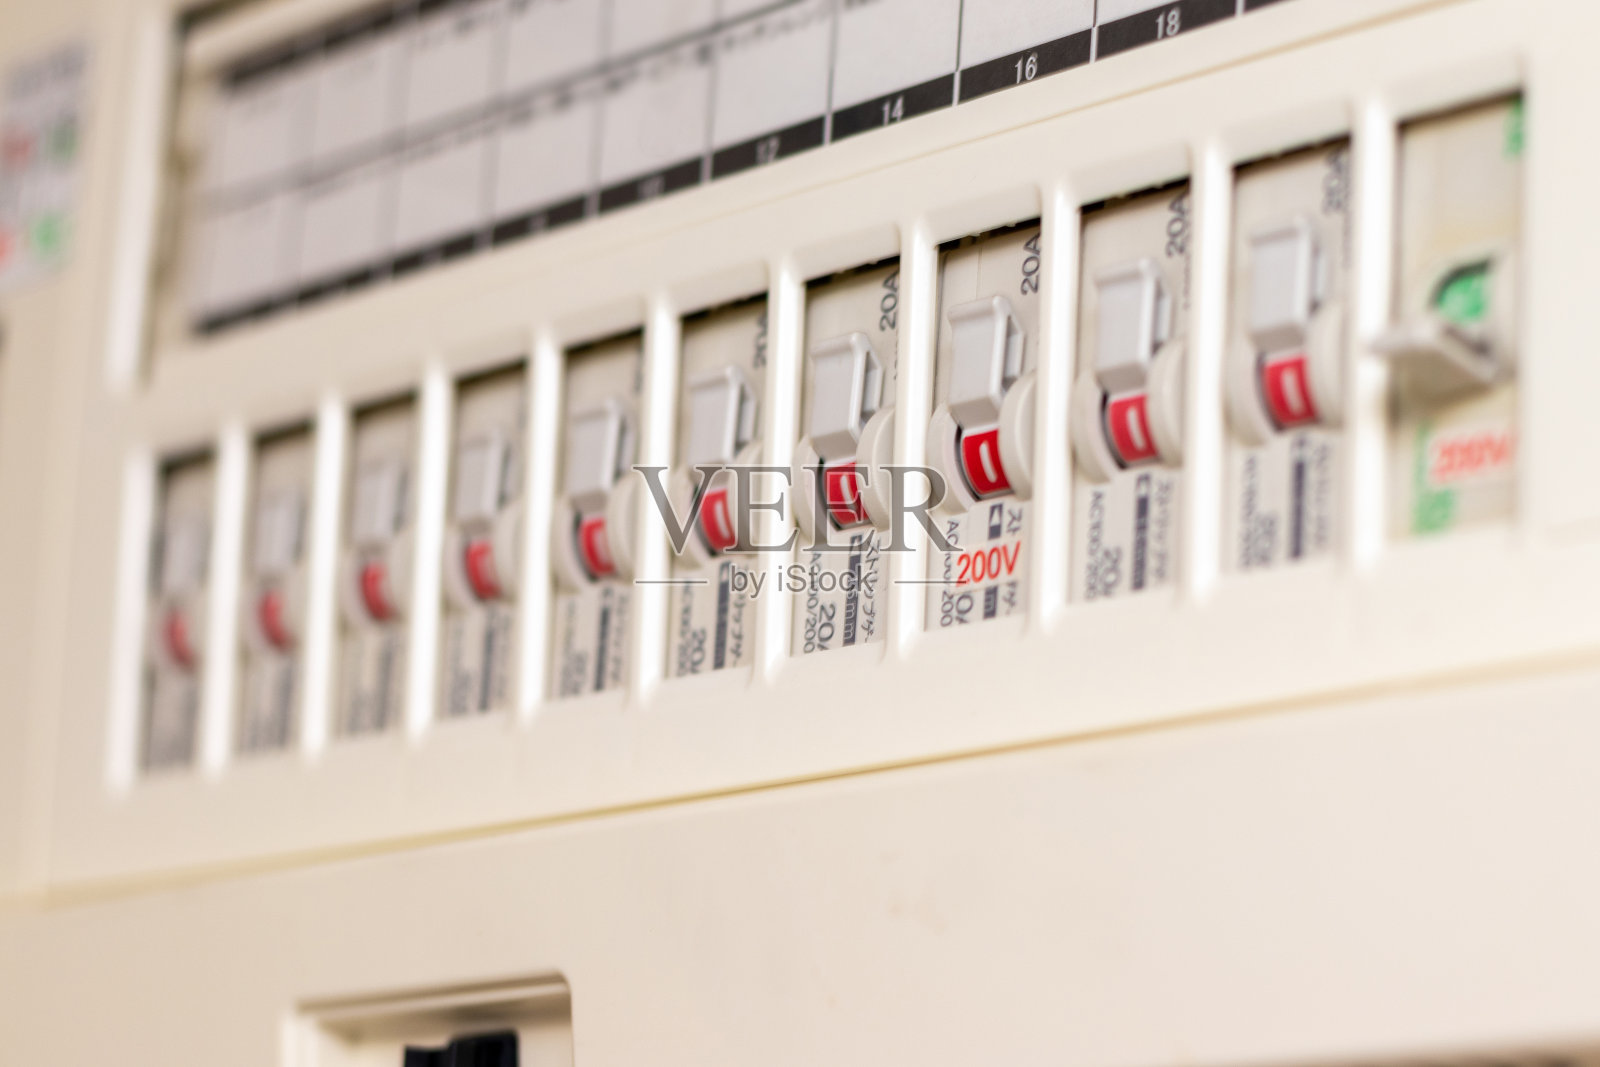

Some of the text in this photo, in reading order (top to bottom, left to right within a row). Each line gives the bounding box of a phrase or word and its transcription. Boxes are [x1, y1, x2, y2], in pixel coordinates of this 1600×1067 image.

[1156, 5, 1181, 40] 18
[1014, 51, 1038, 84] 16
[882, 95, 904, 127] 14
[1020, 231, 1041, 296] 20A
[879, 267, 900, 332] 20A
[955, 540, 1021, 588] 200V
